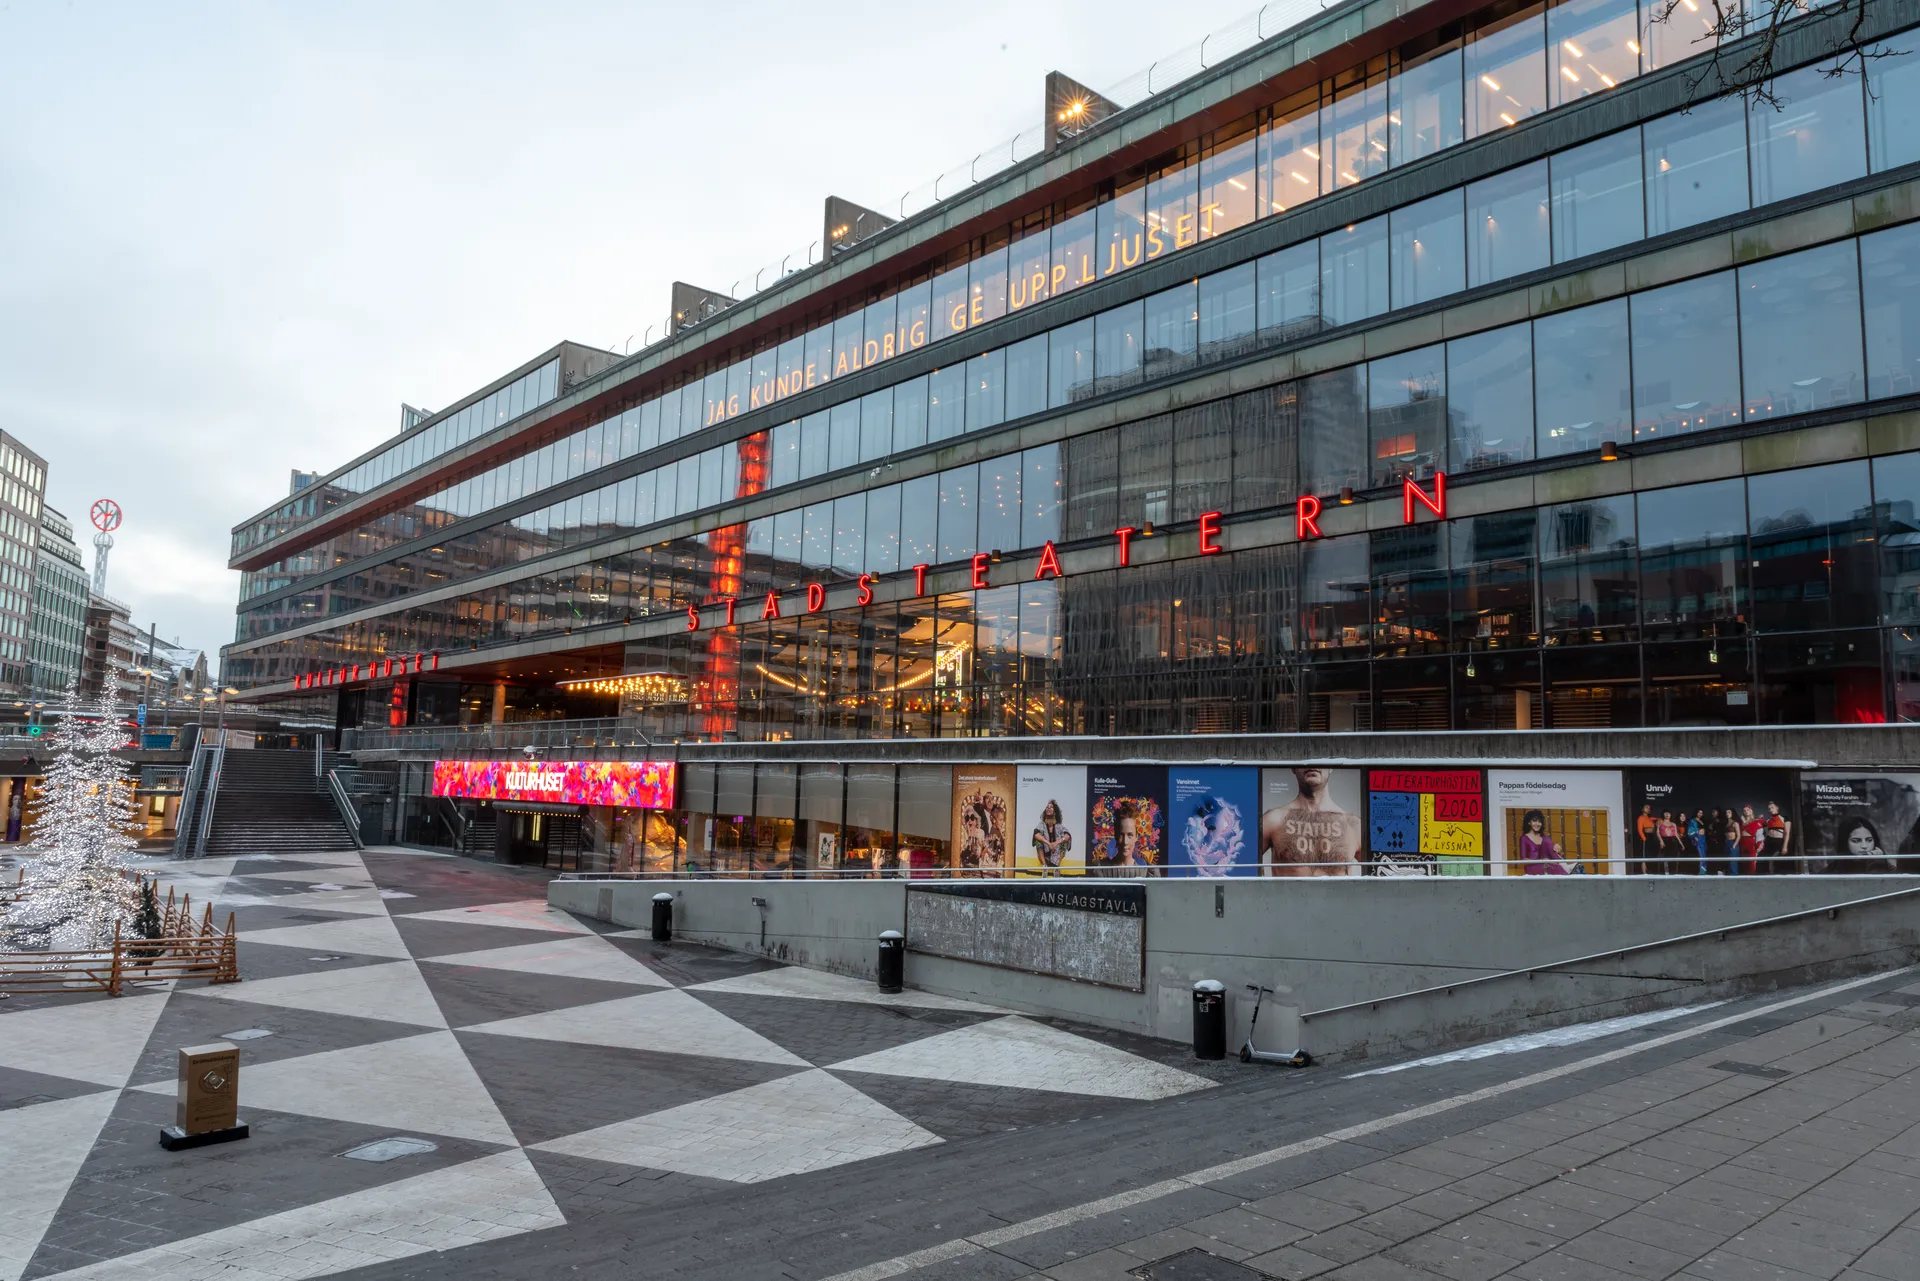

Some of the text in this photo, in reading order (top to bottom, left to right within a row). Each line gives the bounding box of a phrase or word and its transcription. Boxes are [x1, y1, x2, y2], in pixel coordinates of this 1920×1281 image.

[706, 394, 739, 425] JAG
[751, 363, 816, 408] KUNDE
[835, 320, 925, 377] ALDRIG
[951, 295, 984, 331] GE
[1010, 264, 1067, 309] UPP
[688, 471, 1446, 631] STADSTEATERN
[294, 651, 440, 690] KULTURHUSET
[505, 772, 566, 792] KULTURHUSET
[1499, 782, 1567, 790] Pappas födelsedag
[1646, 784, 1673, 793] Unruly
[1815, 784, 1852, 793] Mizeria
[1439, 798, 1478, 818] 2020
[1286, 820, 1342, 837] STATUS
[1040, 891, 1138, 914] ANSLAGSTAVLA
